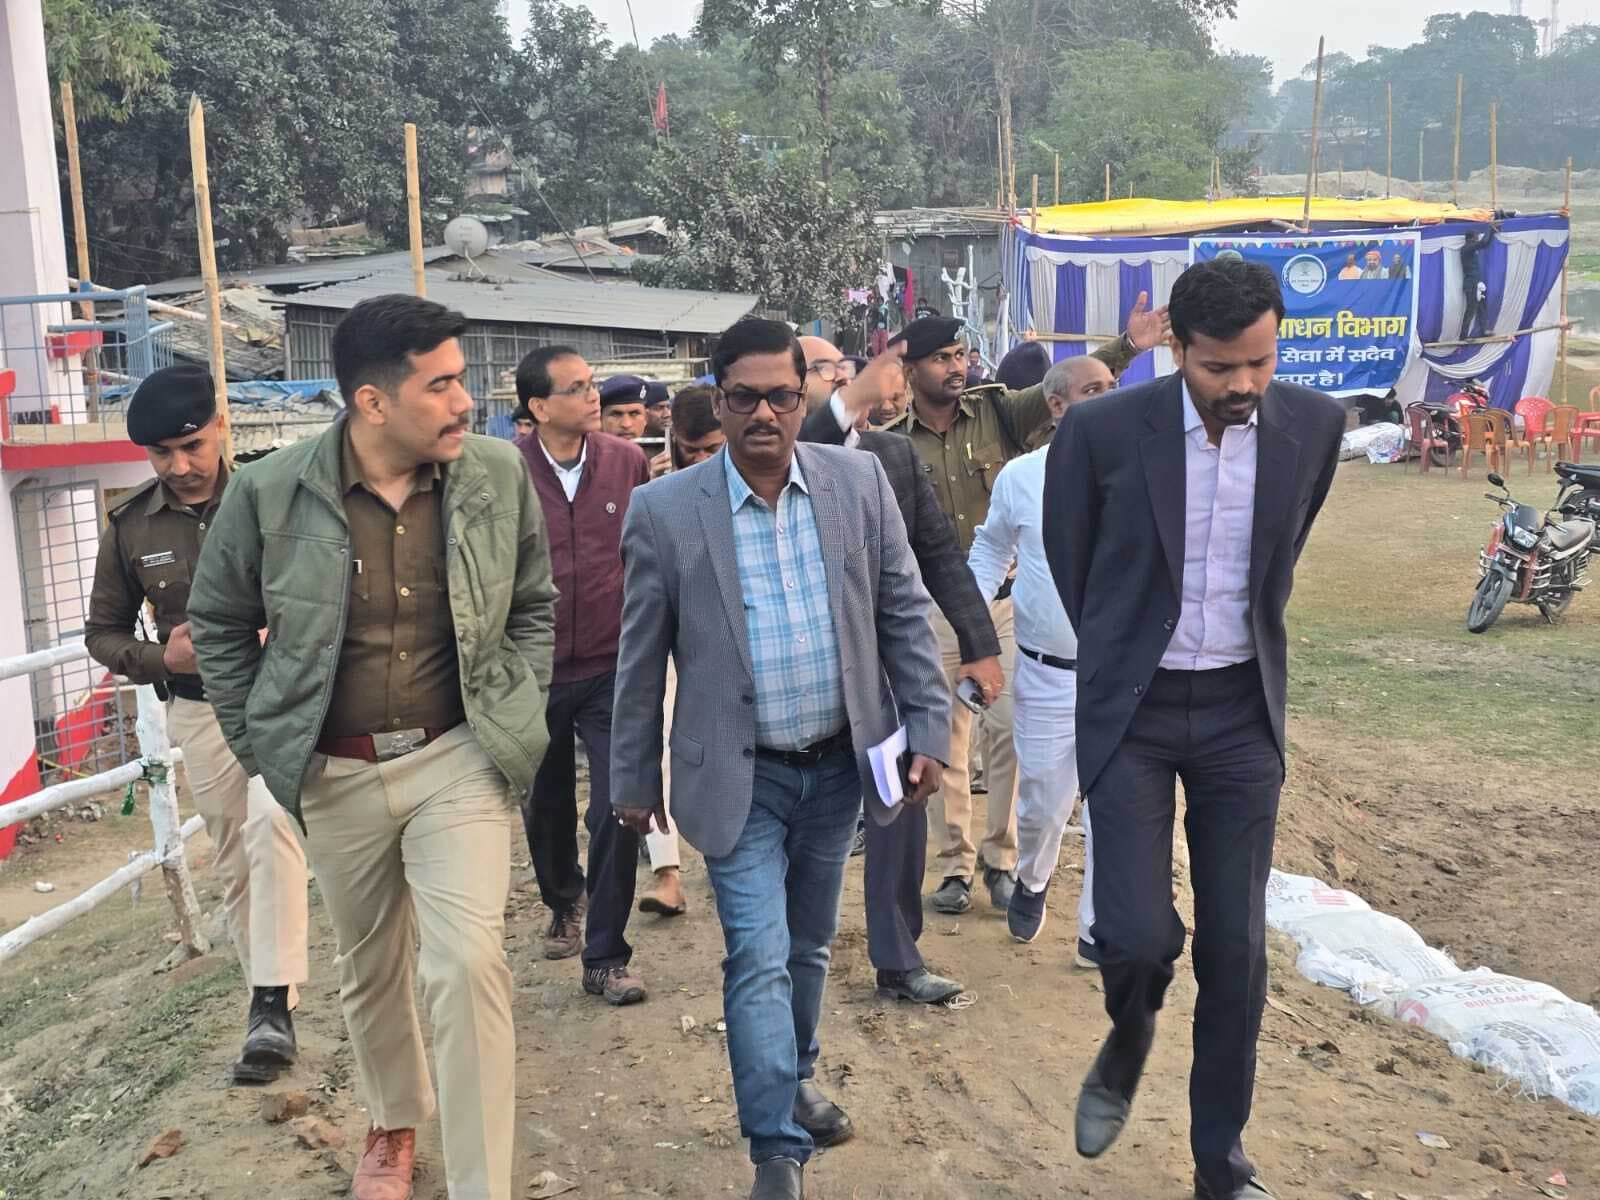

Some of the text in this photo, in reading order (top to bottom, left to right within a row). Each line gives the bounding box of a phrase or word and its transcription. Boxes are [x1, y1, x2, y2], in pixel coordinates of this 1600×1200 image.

[1336, 310, 1408, 338] विभाग
[1280, 345, 1396, 363] सेवा में सदैव
